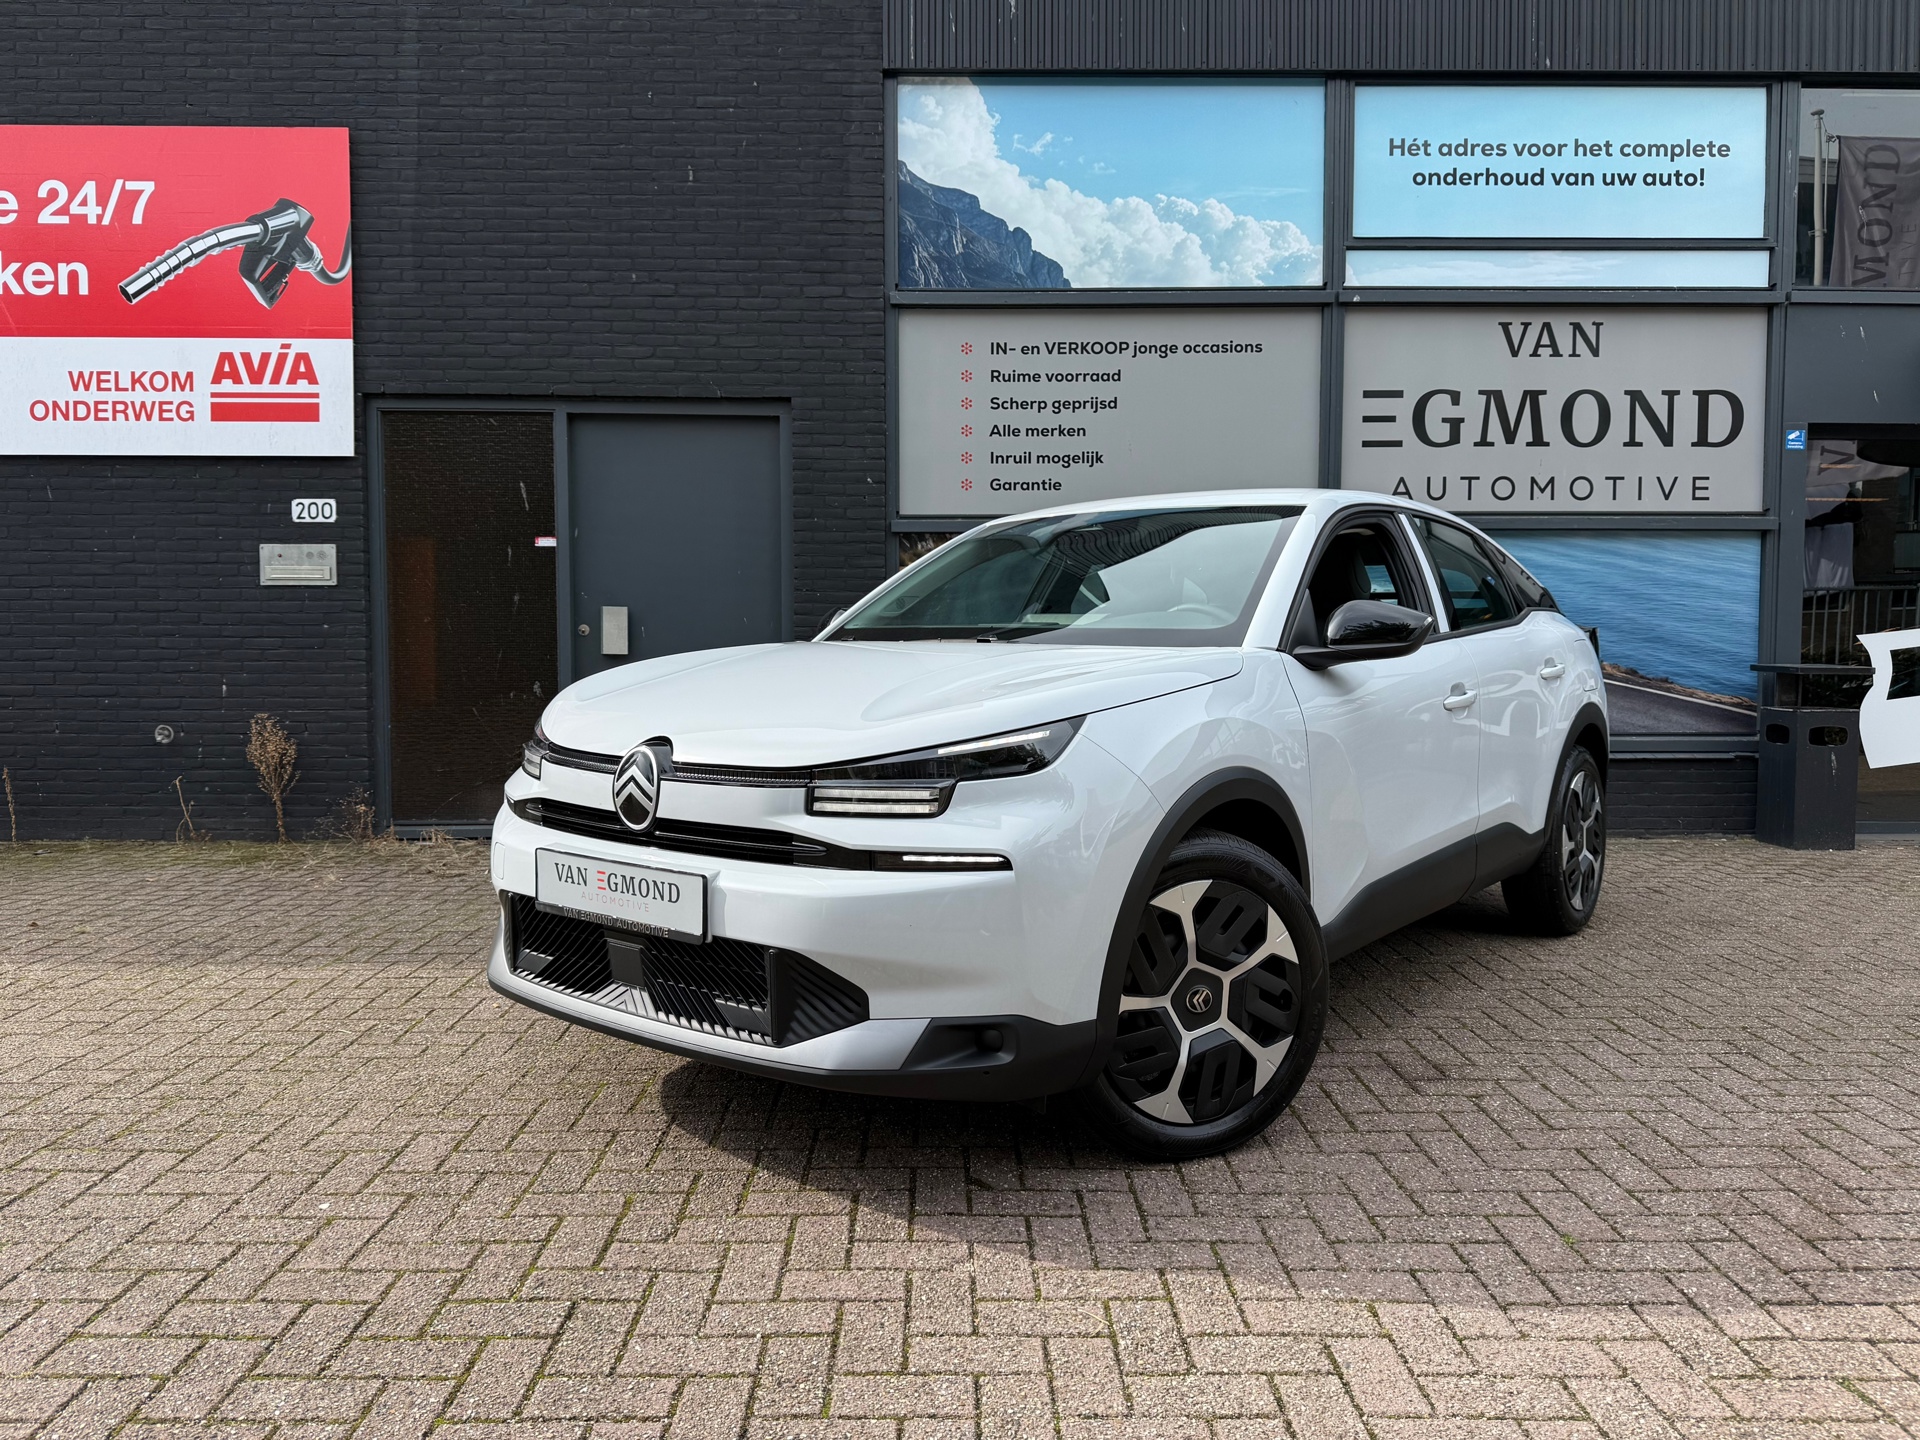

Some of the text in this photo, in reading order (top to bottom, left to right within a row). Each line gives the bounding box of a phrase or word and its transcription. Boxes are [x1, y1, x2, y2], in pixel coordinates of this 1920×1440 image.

[1388, 138, 1731, 162] Hét adres voor het complete
[1412, 168, 1706, 187] onderhoud van uw auto!
[36, 178, 156, 225] 24/7
[990, 341, 1263, 359] IN- en VERKOOP jonge occasions
[1498, 321, 1605, 358] VAN
[68, 371, 194, 392] WELKOM
[990, 369, 1121, 383] Ruime voorraad
[29, 399, 195, 422] ONDERWEG
[990, 396, 1118, 414] Scherp geprijsd
[1361, 388, 1745, 448] EGMOND
[989, 424, 1086, 437] Alle merken
[990, 451, 1104, 468] Inruil mogelijk
[990, 477, 1062, 491] Garantie
[1392, 476, 1711, 501] AUTOMOTIVE
[295, 502, 333, 520] 200
[554, 863, 681, 903] VAN EGMOND
[581, 891, 649, 912] AUTOMOTIVE
[563, 907, 579, 918] VAN
[616, 919, 669, 938] AUTOMOTIVE
